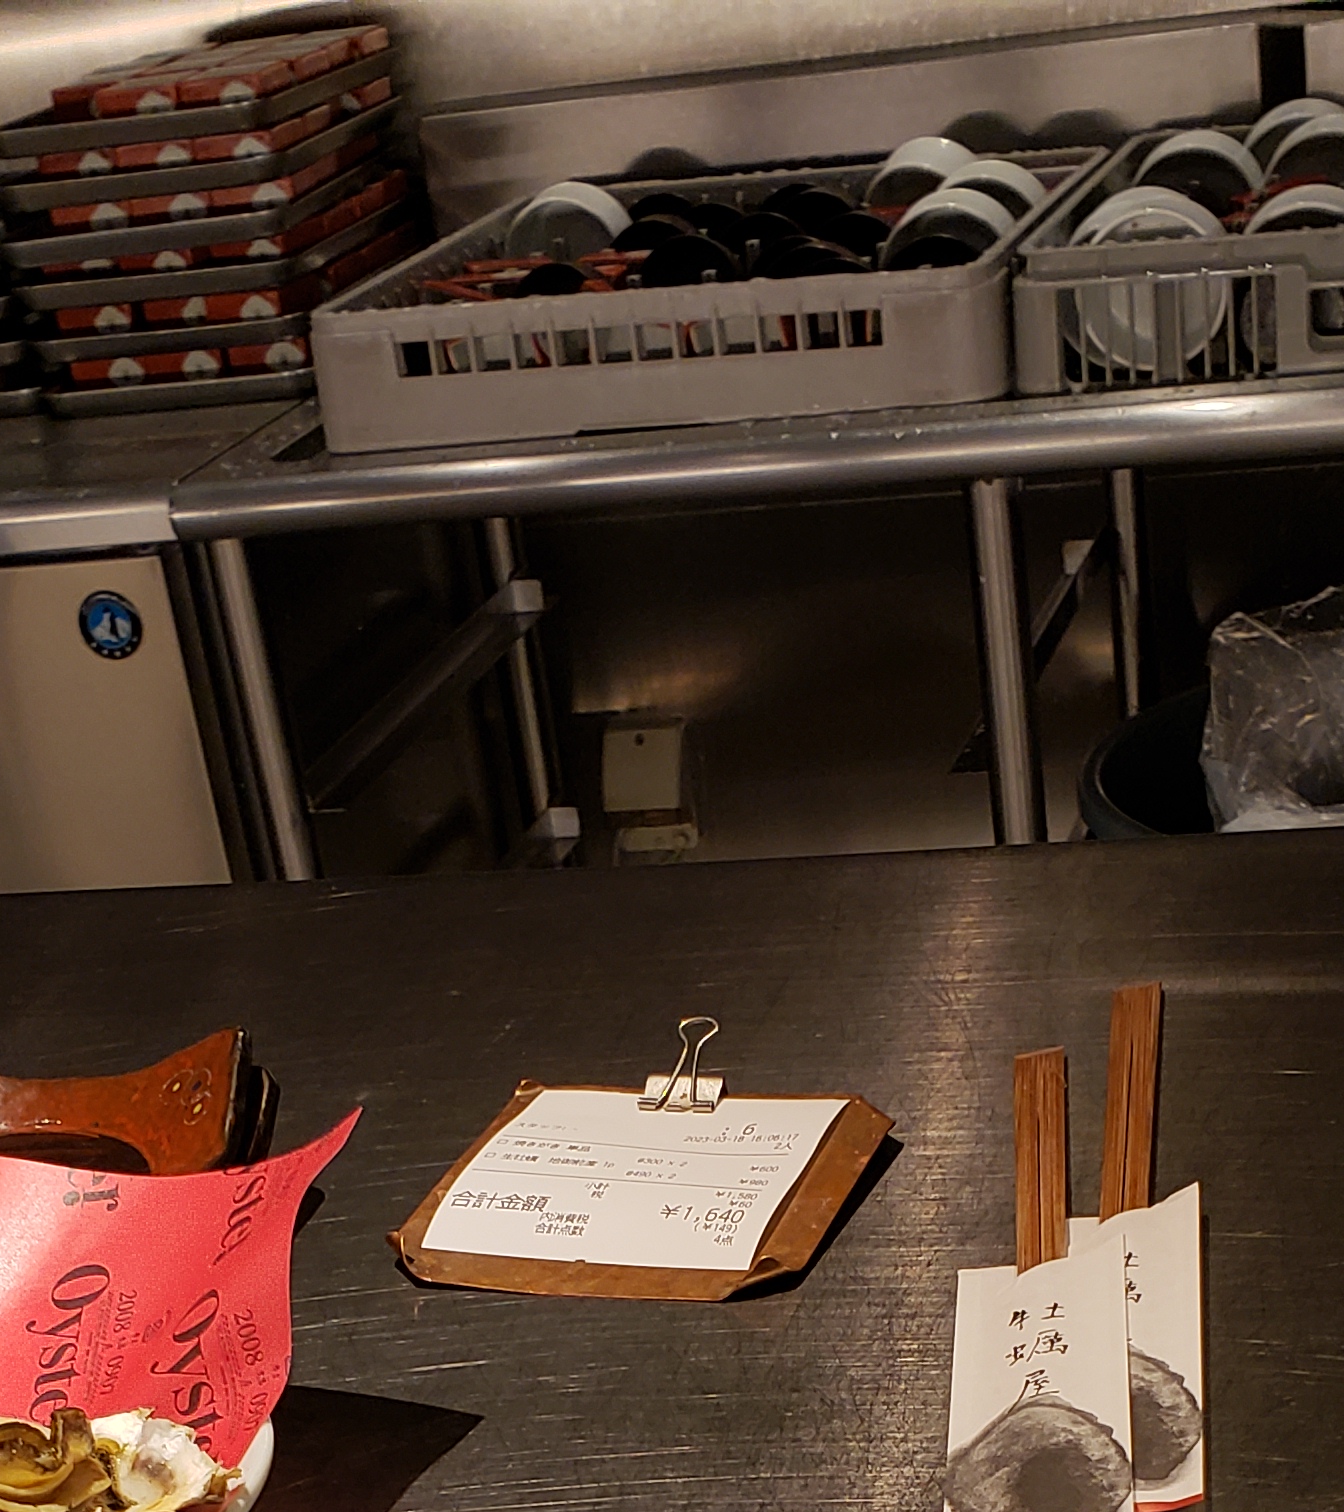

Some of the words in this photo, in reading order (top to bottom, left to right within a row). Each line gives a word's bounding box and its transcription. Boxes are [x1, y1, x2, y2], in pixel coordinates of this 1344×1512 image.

[450, 1190, 551, 1212] 合計金額
[659, 1204, 744, 1225] ¥1,640
[534, 1222, 585, 1237] 合計点数
[112, 1289, 138, 1333] 2008
[26, 1264, 110, 1425] Oyste
[233, 1308, 265, 1367] 2008
